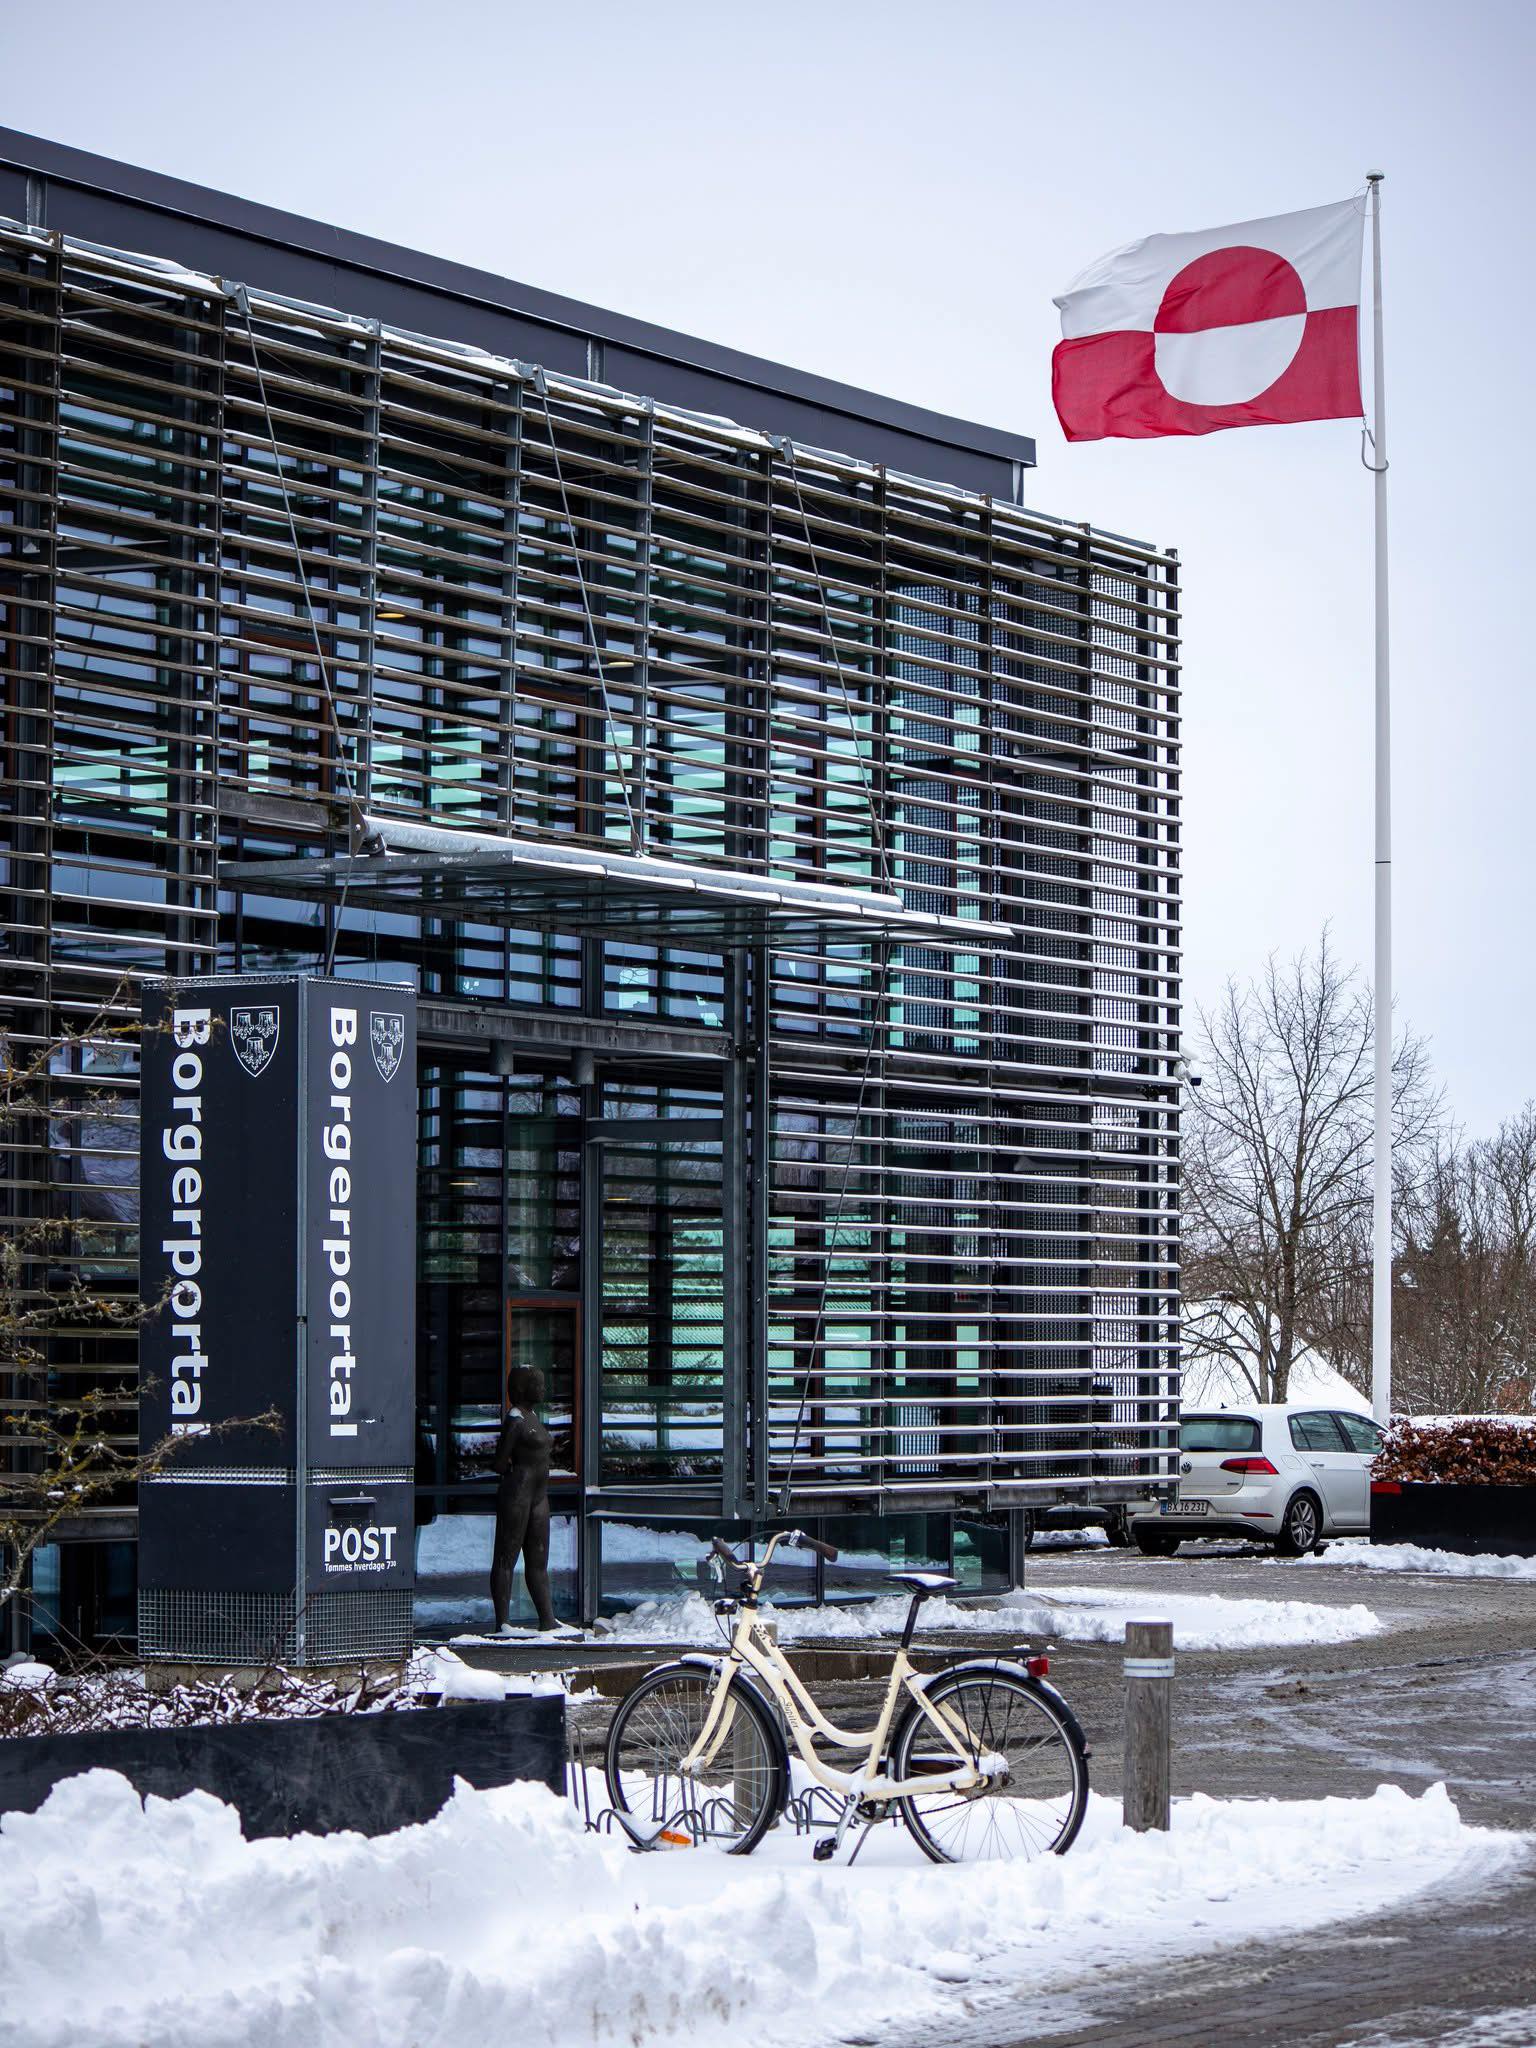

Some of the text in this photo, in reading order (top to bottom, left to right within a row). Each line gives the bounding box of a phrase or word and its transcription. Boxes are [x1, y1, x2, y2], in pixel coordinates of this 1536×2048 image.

[162, 1008, 211, 1437] Borgerportal
[322, 1007, 358, 1437] Borgerportal
[1180, 1502, 1189, 1511] 16
[1190, 1501, 1205, 1511] 231
[324, 1526, 397, 1562] POST
[324, 1563, 353, 1573] Tømmes
[353, 1561, 385, 1572] hverdage
